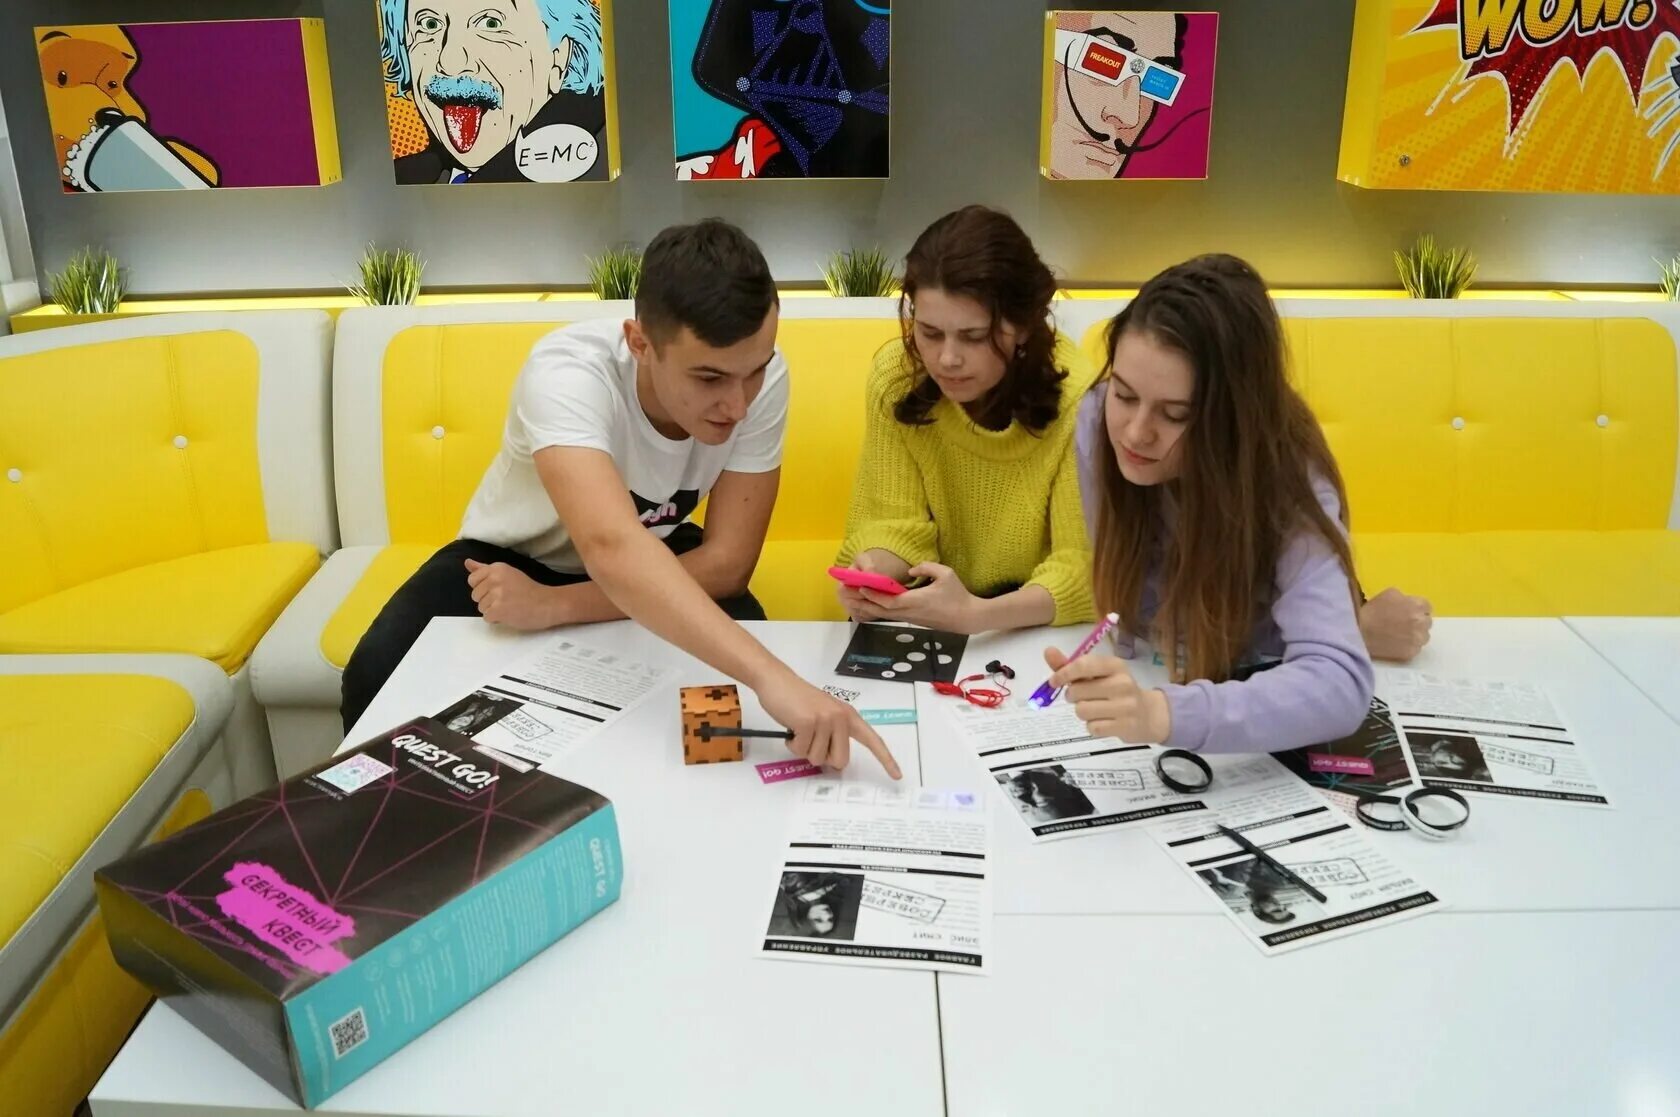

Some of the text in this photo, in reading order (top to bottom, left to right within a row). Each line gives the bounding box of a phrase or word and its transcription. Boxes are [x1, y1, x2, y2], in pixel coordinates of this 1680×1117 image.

[1089, 52, 1122, 69] FREAKOUT
[391, 734, 463, 768] QUEST
[452, 763, 500, 789] GO!
[762, 767, 783, 779] GO!
[241, 874, 342, 936] СЕКРЕТНЫЙ
[262, 918, 324, 957] КВЕСТ
[934, 953, 977, 964] ГЛАВНОЕ
